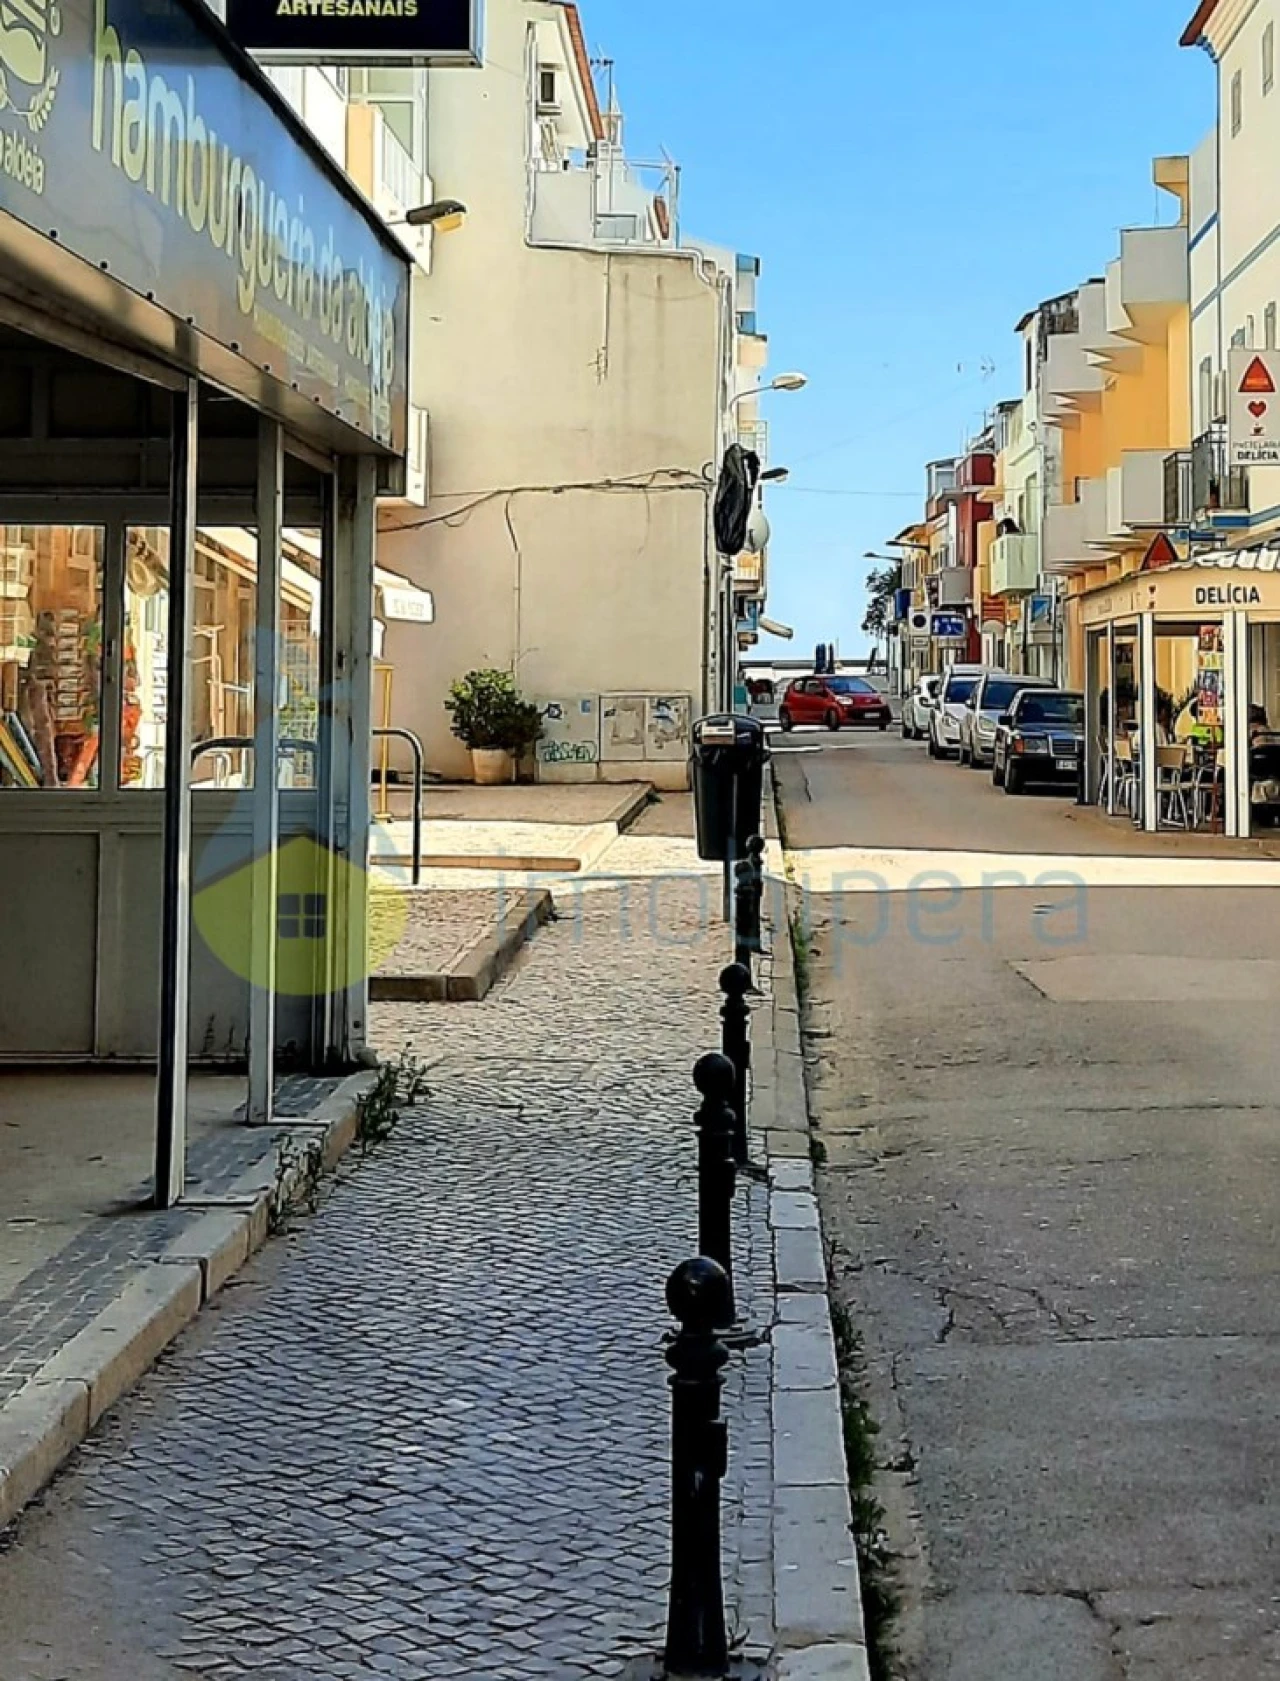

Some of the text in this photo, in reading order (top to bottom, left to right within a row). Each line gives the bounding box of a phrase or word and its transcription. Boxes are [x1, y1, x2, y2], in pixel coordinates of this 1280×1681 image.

[276, 0, 417, 16] ARTESANAIS
[93, 0, 314, 320] hamburgueria
[320, 225, 344, 343] da
[347, 255, 394, 388] aldeia
[1195, 582, 1261, 604] DELÍCIA
